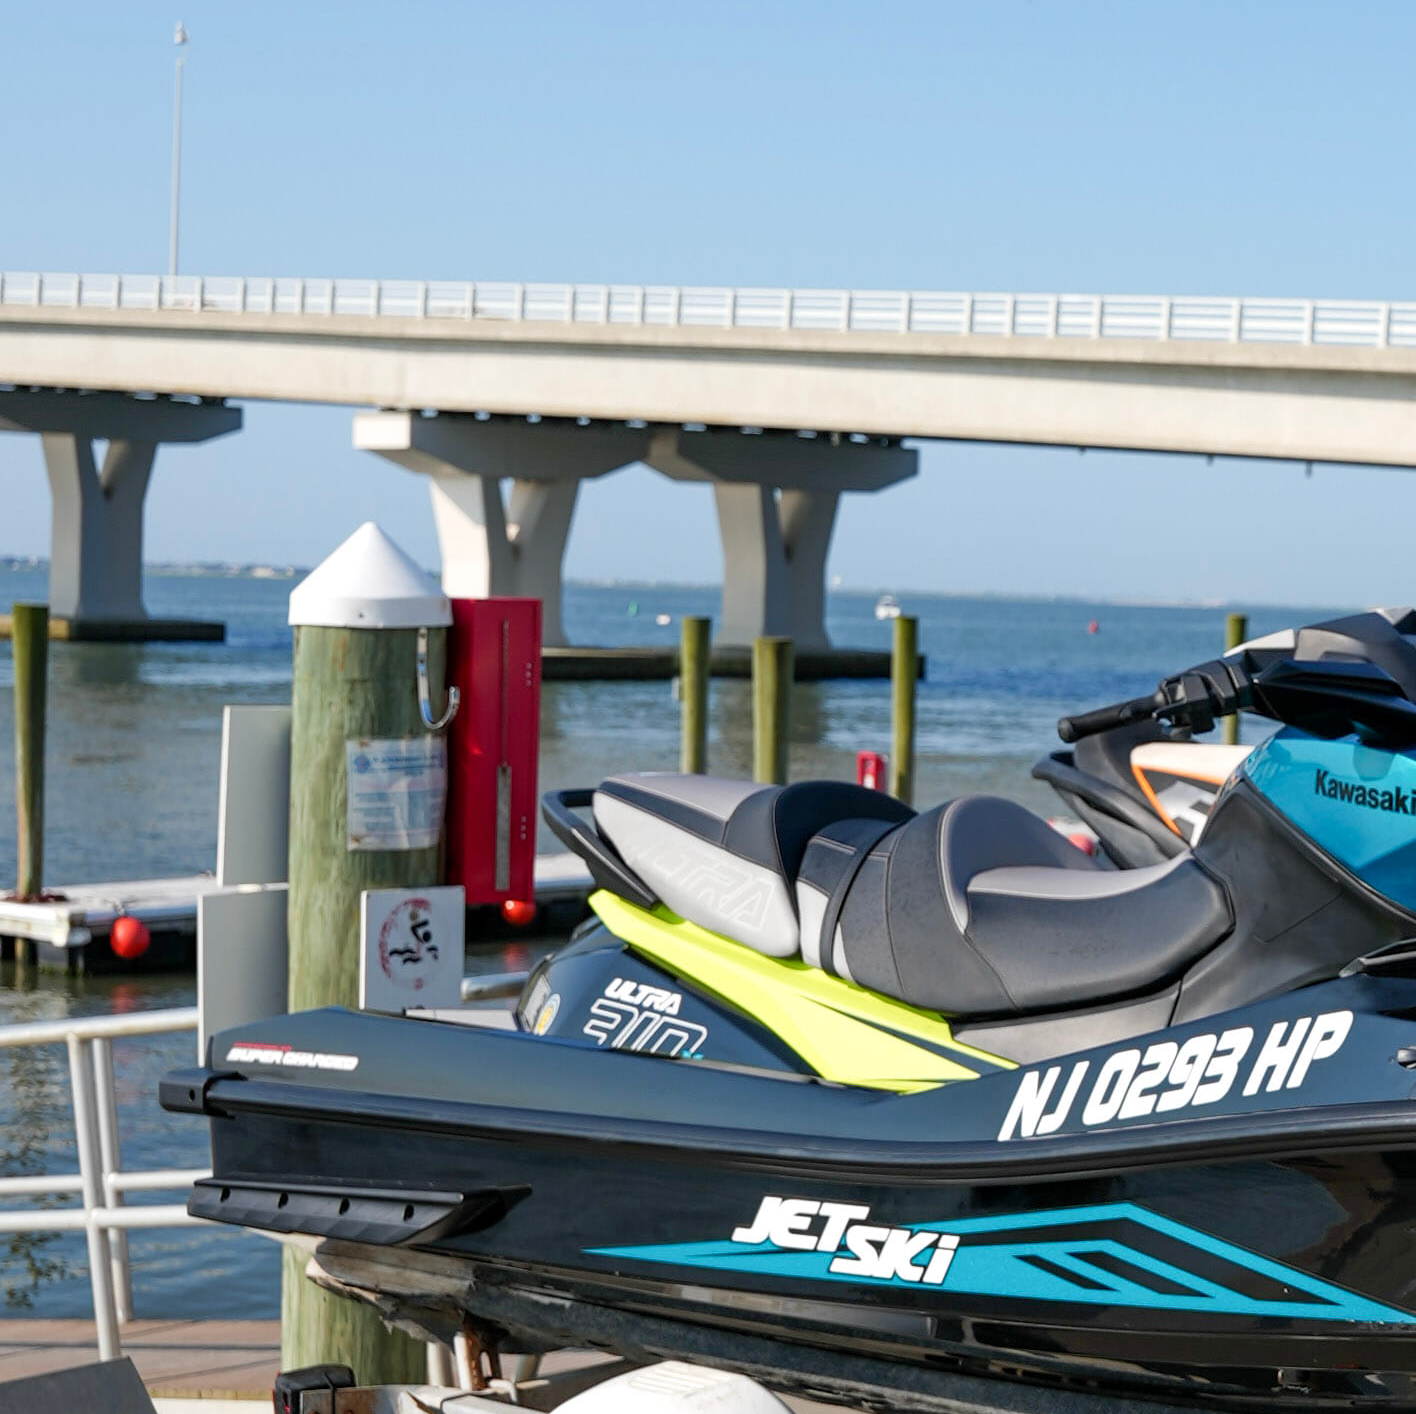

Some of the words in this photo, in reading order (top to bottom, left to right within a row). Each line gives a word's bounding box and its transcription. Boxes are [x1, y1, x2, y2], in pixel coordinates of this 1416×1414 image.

[637, 842, 777, 932] LTRA
[604, 977, 682, 1016] ULTRA
[997, 1060, 1090, 1142] NJ
[1082, 1026, 1254, 1126] 0293
[1242, 1010, 1354, 1097] HP
[731, 1195, 870, 1253] JET
